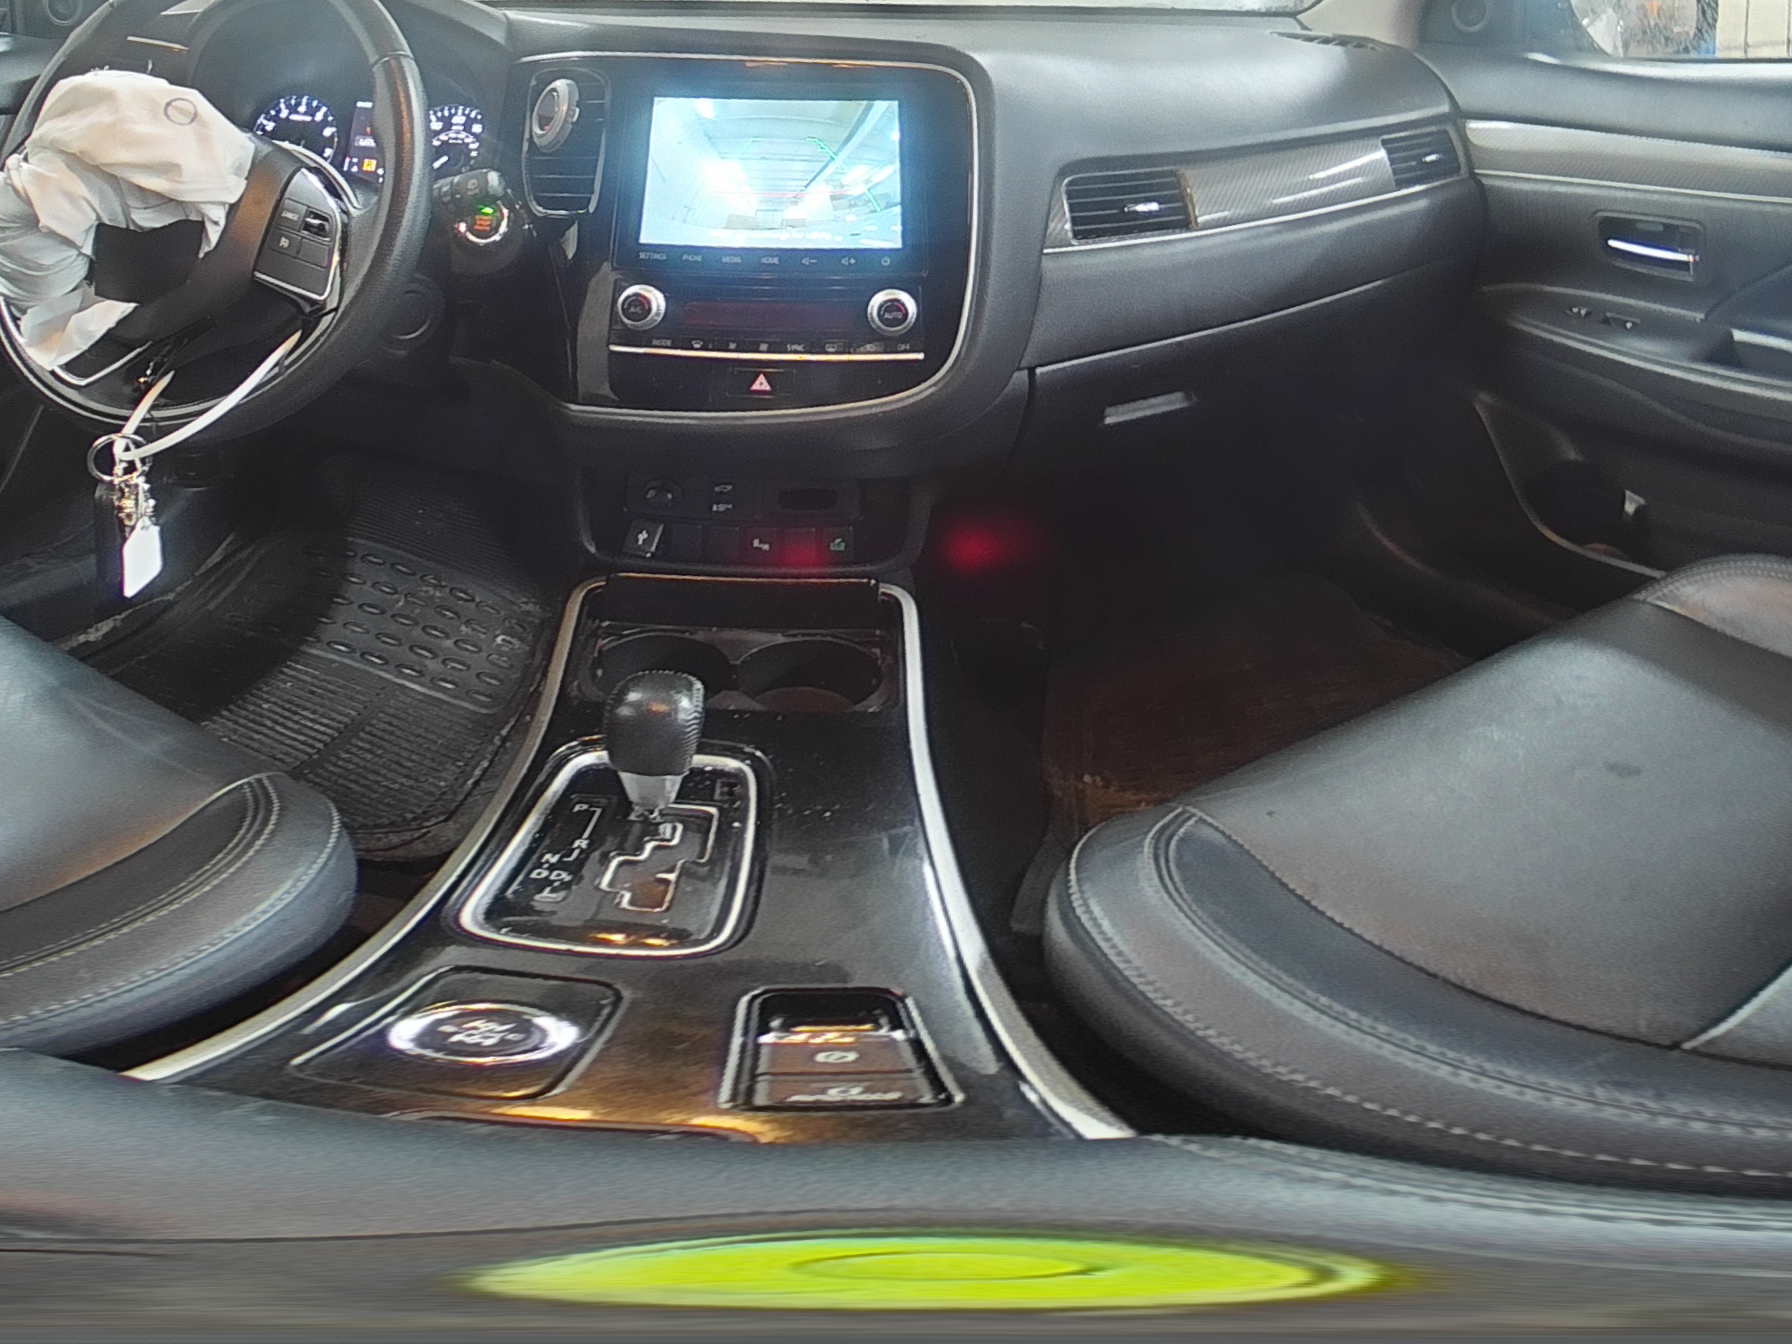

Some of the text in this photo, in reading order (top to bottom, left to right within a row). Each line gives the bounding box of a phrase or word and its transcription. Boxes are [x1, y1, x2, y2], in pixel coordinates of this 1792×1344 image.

[883, 311, 903, 319] AUTO
[572, 803, 590, 812] P
[571, 839, 590, 849] R
[541, 853, 562, 864] N
